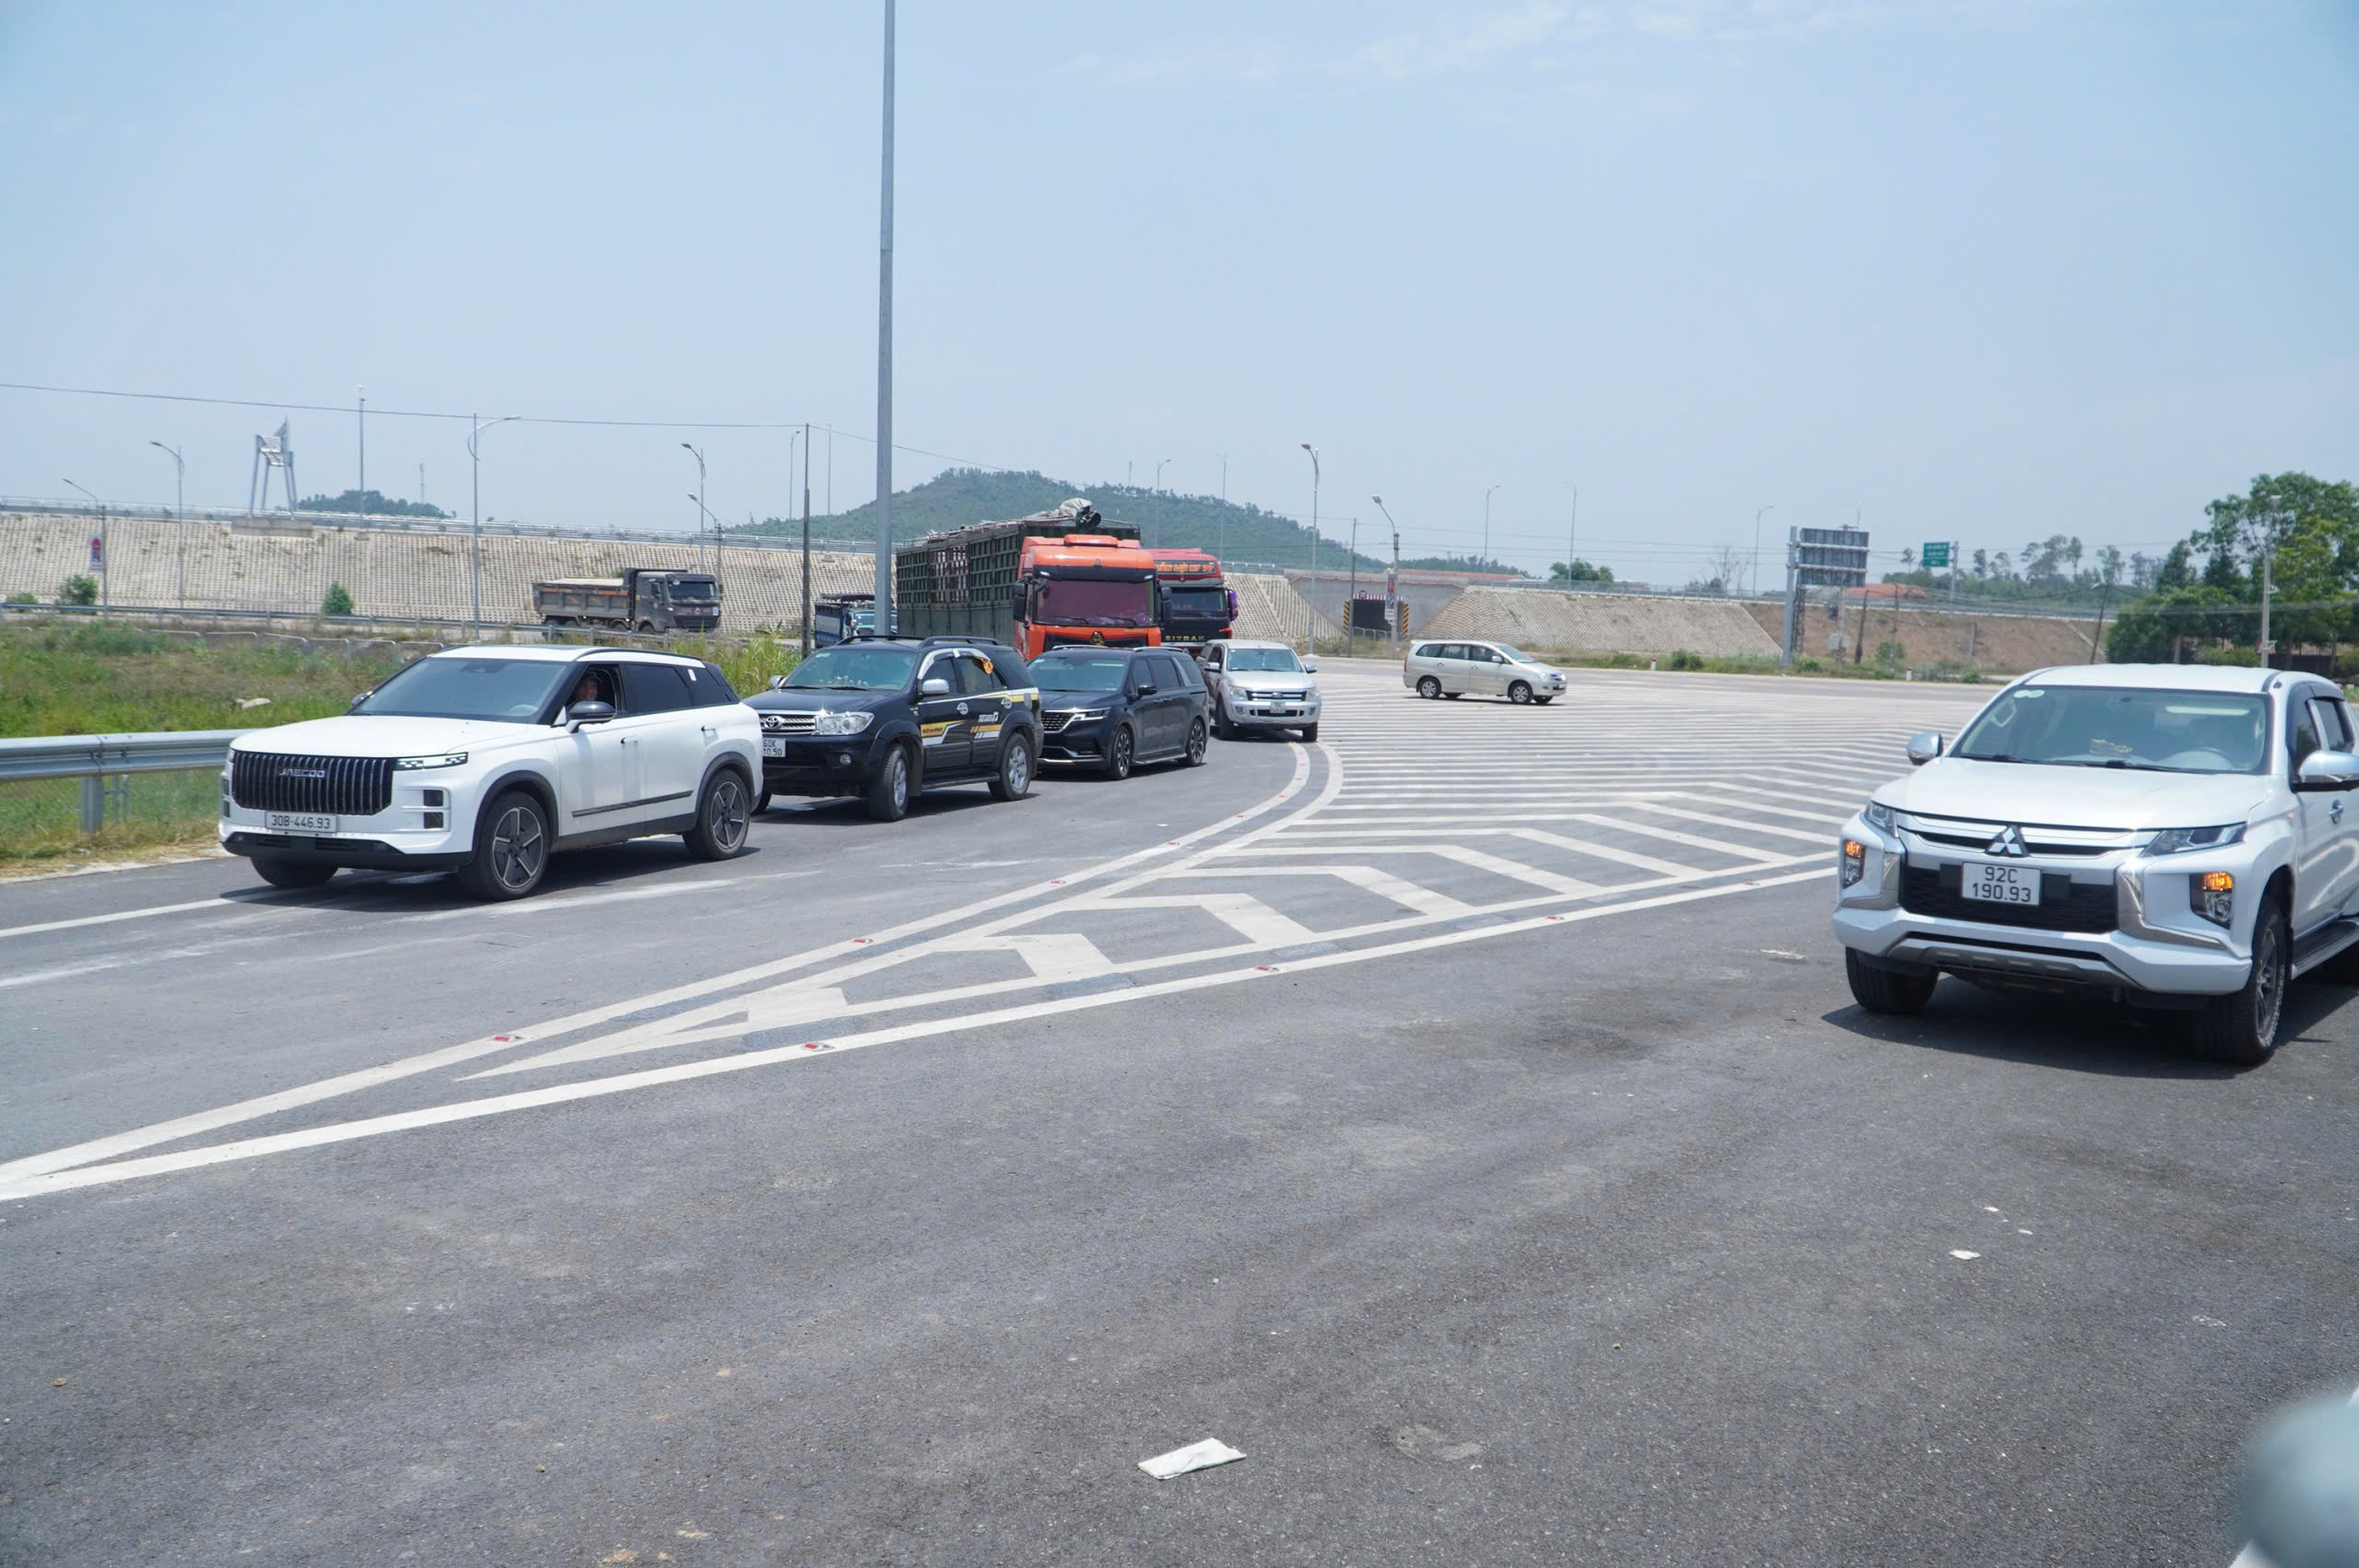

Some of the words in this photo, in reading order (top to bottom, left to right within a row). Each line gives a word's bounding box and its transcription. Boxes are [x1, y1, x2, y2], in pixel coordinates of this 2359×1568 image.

[763, 748, 782, 756] 10.50
[279, 768, 325, 778] JAECOO
[271, 814, 331, 829] 30B-446.93
[1984, 866, 2018, 883] 92C
[1972, 882, 2032, 903] 190.93
